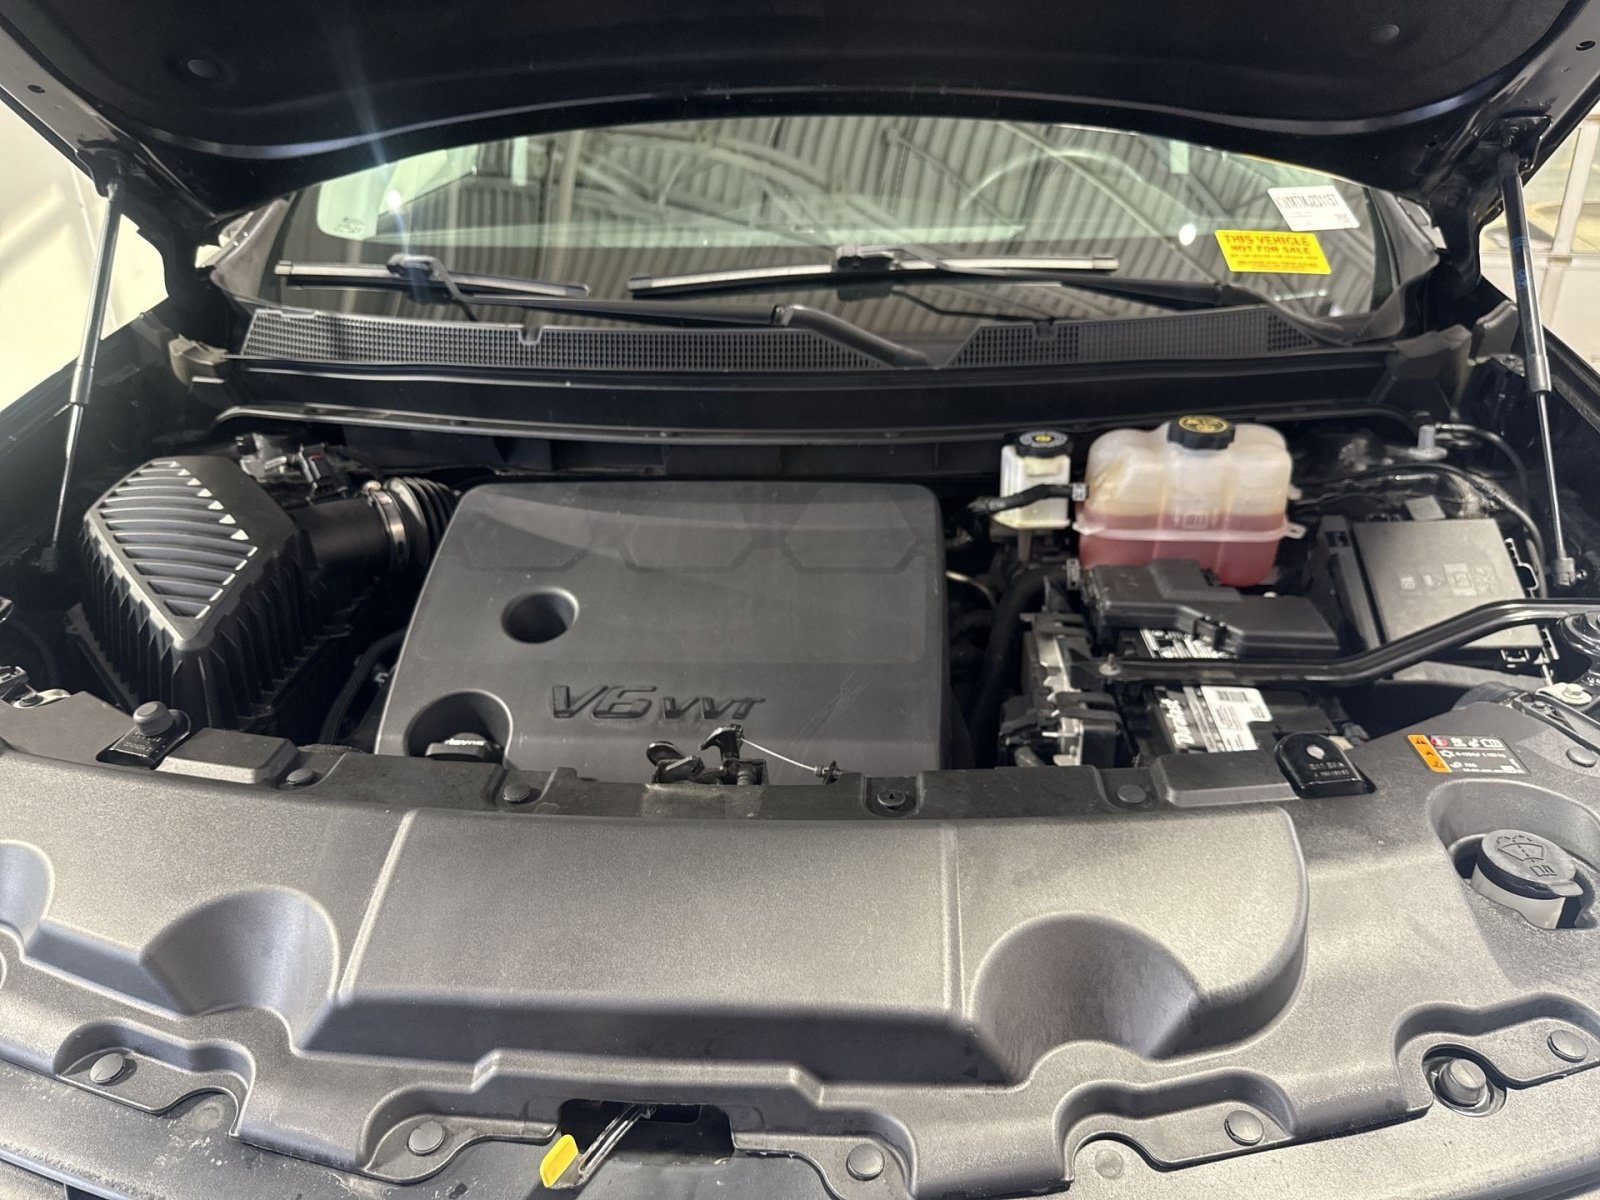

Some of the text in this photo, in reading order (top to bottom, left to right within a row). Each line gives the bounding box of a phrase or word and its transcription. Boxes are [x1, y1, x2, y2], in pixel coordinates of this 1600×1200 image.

[1224, 234, 1310, 246] THIS VEHICLE
[1230, 245, 1253, 253] NOT
[1282, 246, 1312, 254] SALE
[552, 685, 766, 720] V6 VVT
